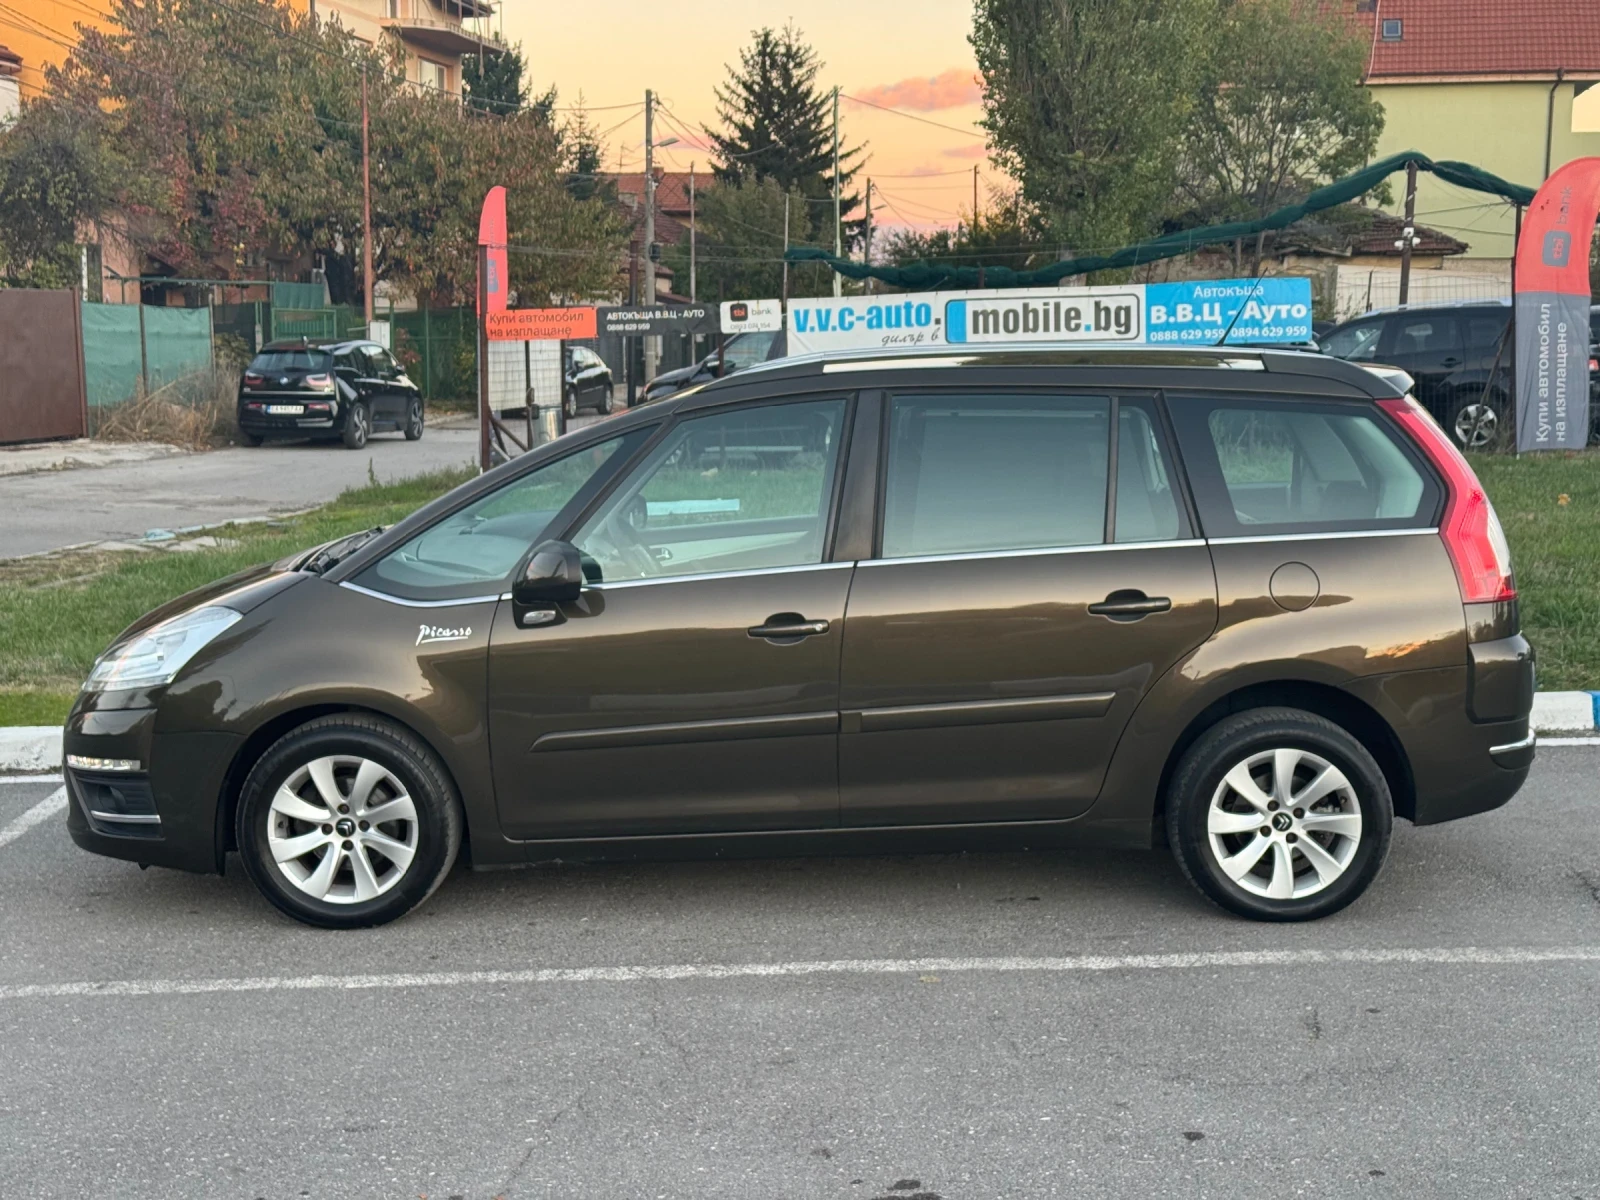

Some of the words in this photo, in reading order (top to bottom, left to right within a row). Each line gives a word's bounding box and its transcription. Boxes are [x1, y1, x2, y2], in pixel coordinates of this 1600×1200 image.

[1556, 187, 1572, 225] bank
[1552, 238, 1565, 259] tbi
[1193, 285, 1264, 298] Автокъща
[489, 313, 516, 326] Купи
[518, 312, 584, 324] автомобил
[606, 311, 654, 321] АВТОКЪЩА
[655, 310, 677, 319] В.В.Ц
[683, 309, 705, 318] АУТО
[733, 308, 745, 317] tbi
[751, 308, 772, 316] bank
[972, 300, 1131, 335] mobile.bg
[1150, 302, 1222, 325] В.В.Ц
[1242, 301, 1307, 324] Ауто
[490, 328, 503, 337] на
[505, 326, 572, 338] изплащане
[625, 323, 637, 331] 629
[1150, 331, 1178, 341] 0888
[1180, 329, 1202, 340] 629
[1204, 328, 1224, 338] 959
[1230, 327, 1259, 338] 0894
[1261, 326, 1283, 337] 629
[1285, 325, 1307, 336] 959
[1538, 303, 1551, 398] автомобил
[1556, 321, 1568, 417] изплащане
[1535, 403, 1551, 442] Купи
[1555, 424, 1566, 442] на
[415, 624, 472, 646] Picasso
